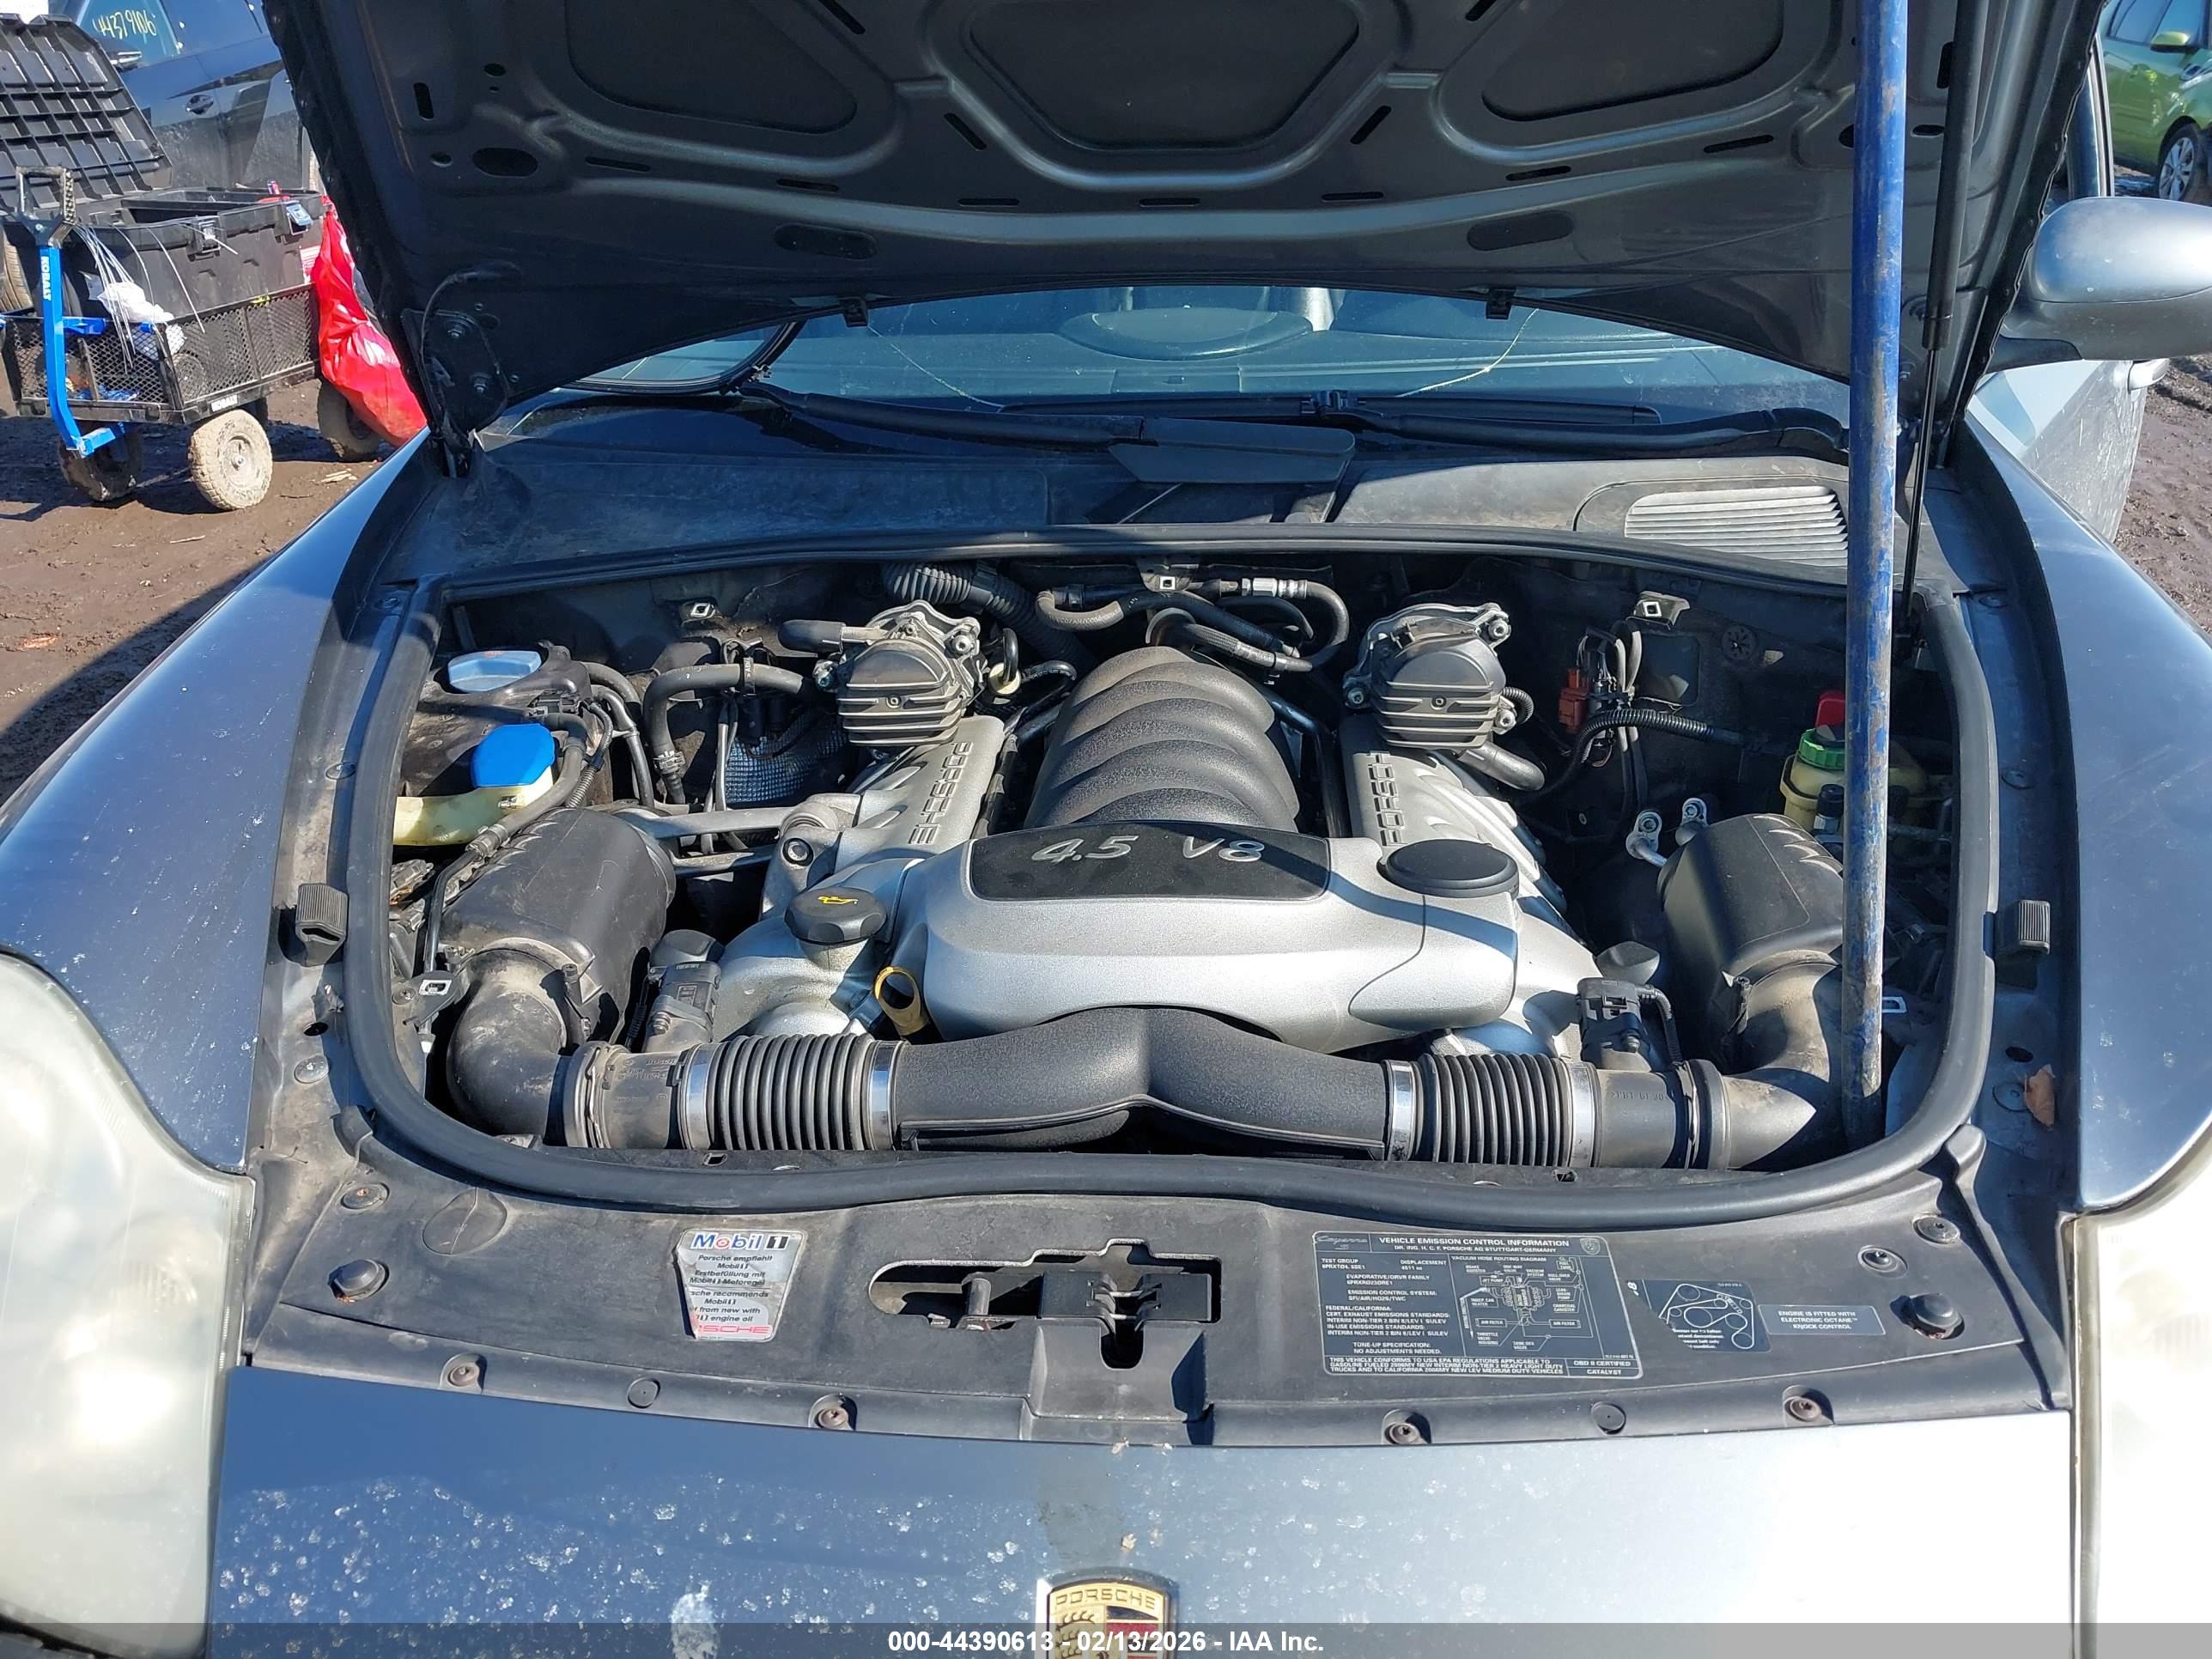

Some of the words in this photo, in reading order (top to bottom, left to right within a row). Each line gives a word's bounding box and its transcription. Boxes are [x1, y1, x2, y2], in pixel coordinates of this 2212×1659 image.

[40, 256, 52, 301] KOBALT
[908, 742, 973, 845] PORSCHE
[1367, 750, 1408, 847] PORSCH
[1031, 836, 1139, 862] 4.5
[1182, 836, 1265, 862] V8
[692, 1234, 762, 1249] Mobil
[1055, 1589, 1156, 1610] PORSCHE
